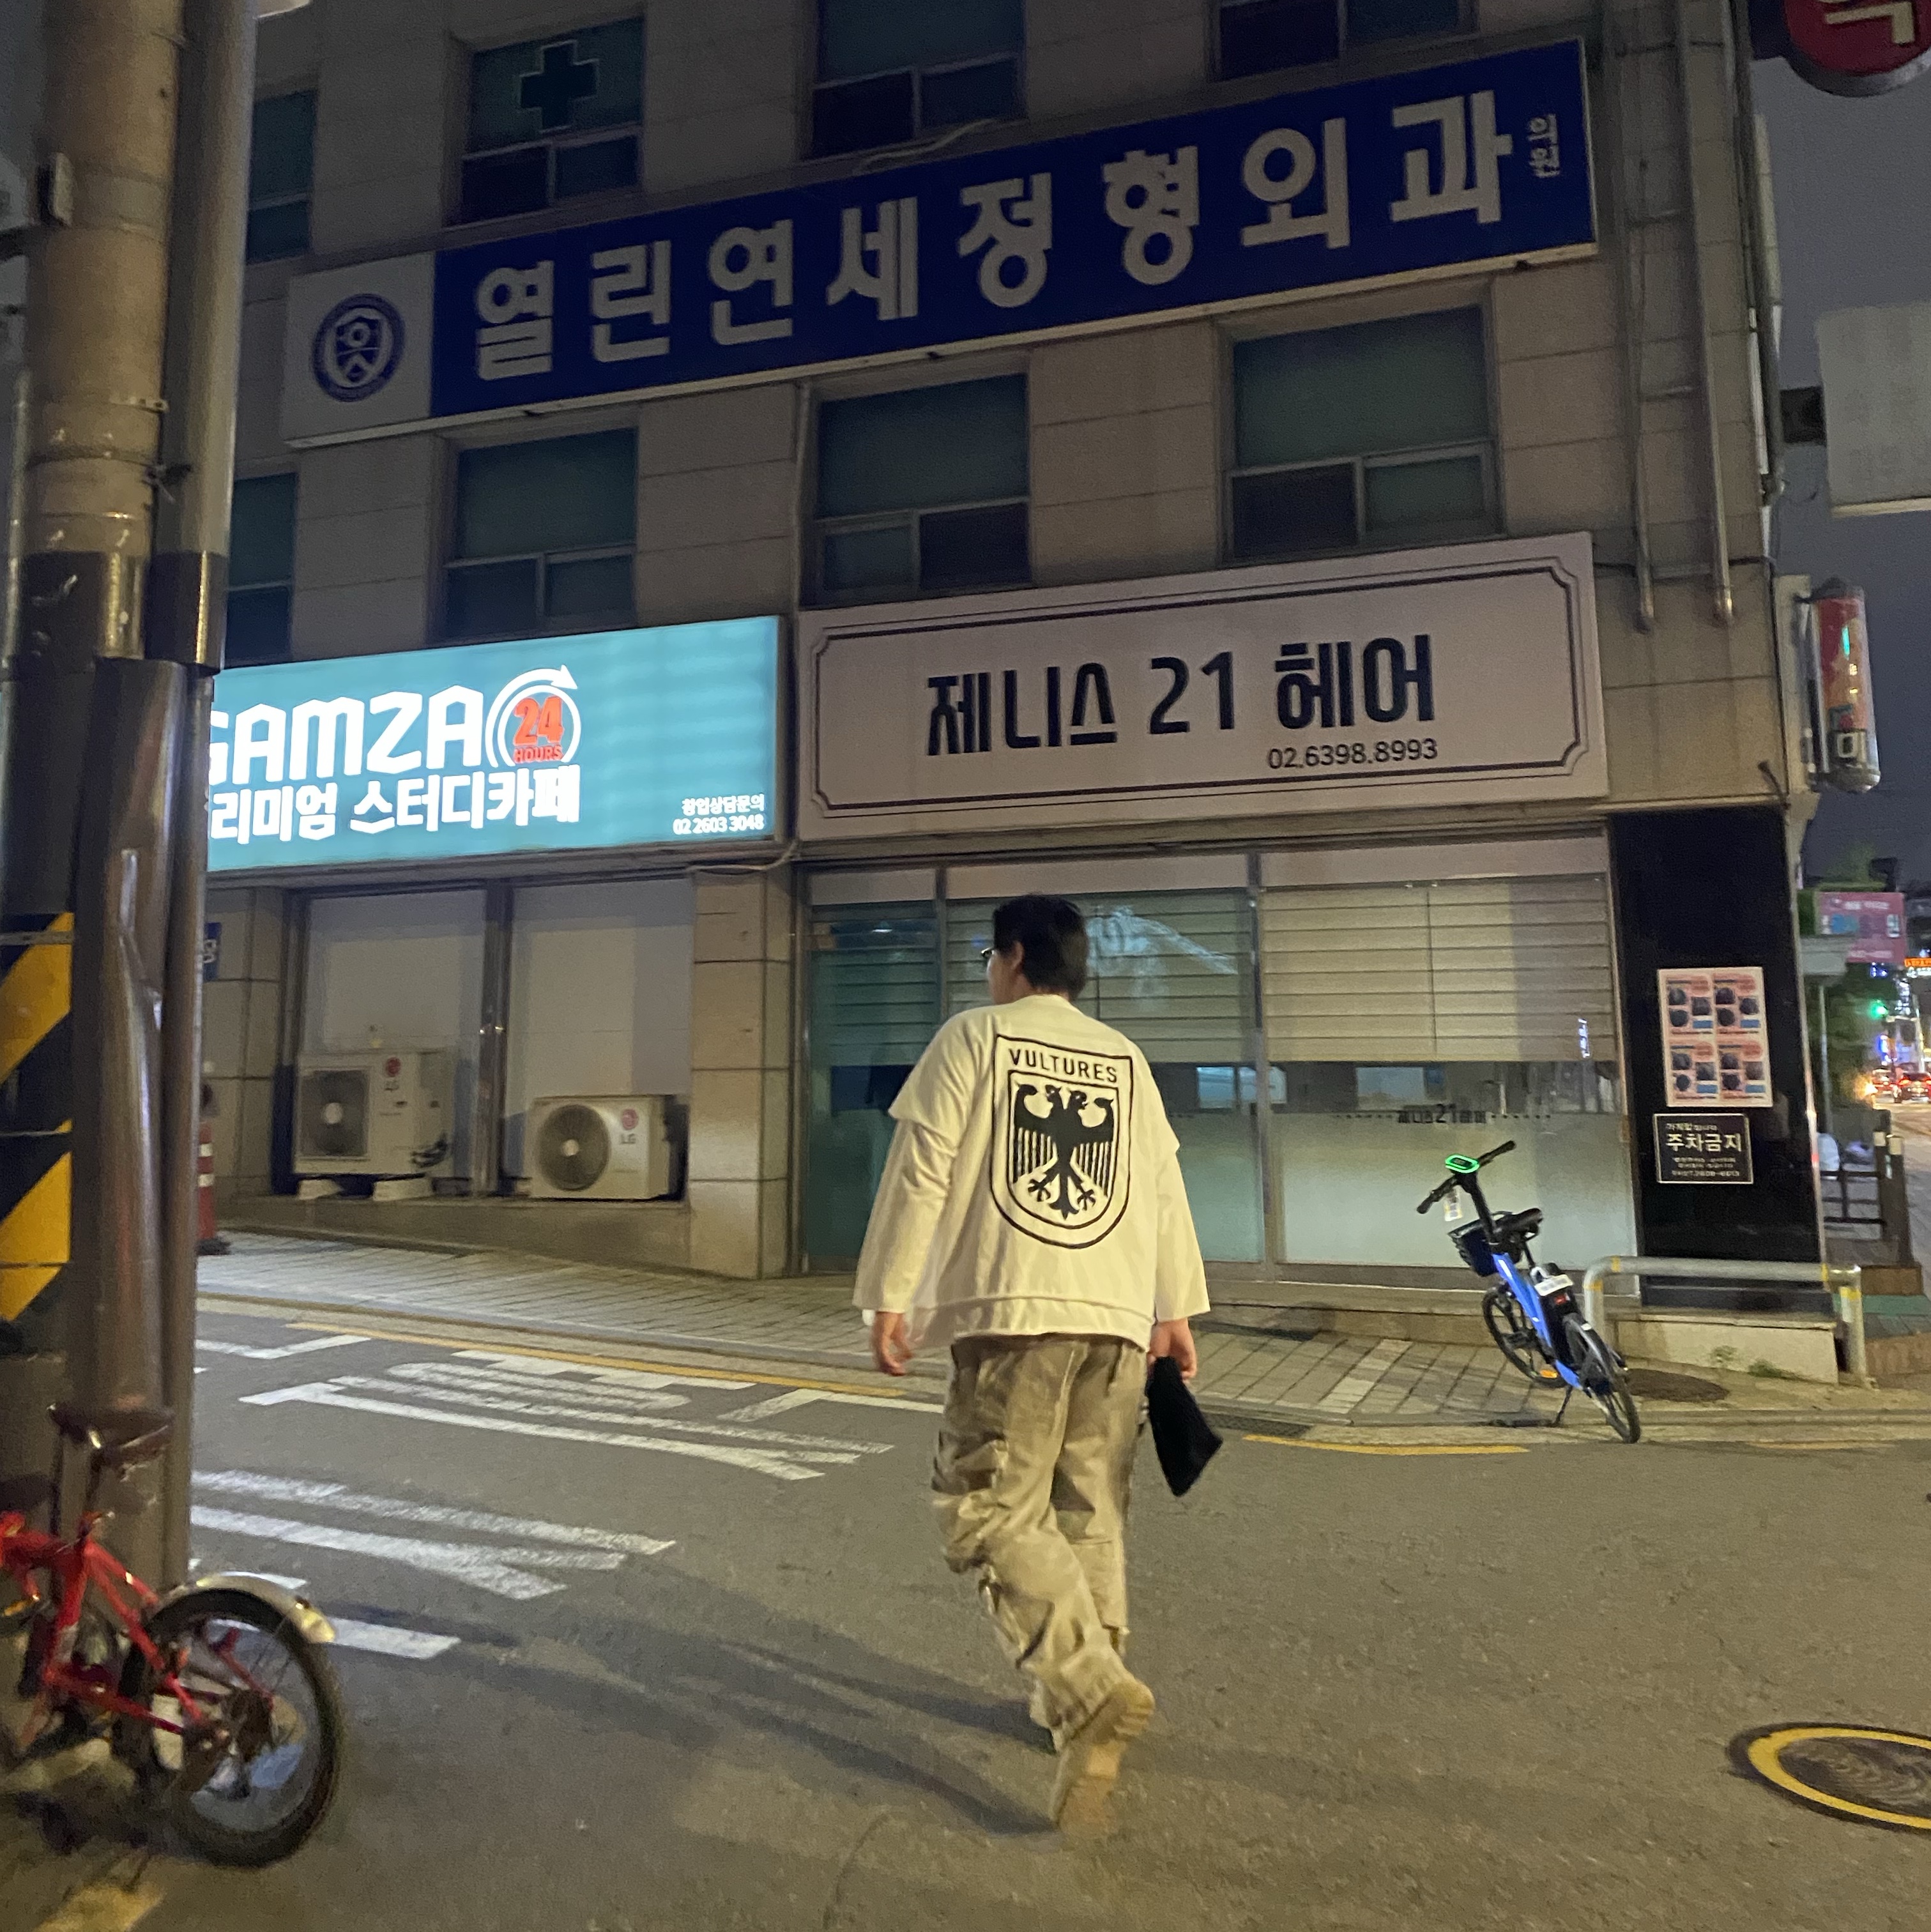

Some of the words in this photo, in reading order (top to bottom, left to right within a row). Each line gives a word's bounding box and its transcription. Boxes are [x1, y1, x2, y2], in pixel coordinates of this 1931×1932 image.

[1526, 114, 1560, 178] 의원
[927, 662, 1117, 756] 제니스
[1149, 651, 1235, 734] 21
[1275, 634, 1435, 729] 헤어
[513, 695, 565, 746] 24
[514, 745, 563, 764] HOURS
[1267, 738, 1438, 769] 02.6398.8993
[210, 782, 337, 844] 리미엄
[350, 764, 581, 834] 스터디카페
[681, 793, 765, 816] 창업상담문의
[673, 818, 692, 835] 02
[728, 814, 765, 832] 3048
[1009, 1048, 1118, 1084] VULTURES
[619, 1133, 637, 1145] LG
[1665, 1132, 1743, 1152] 주차금지
